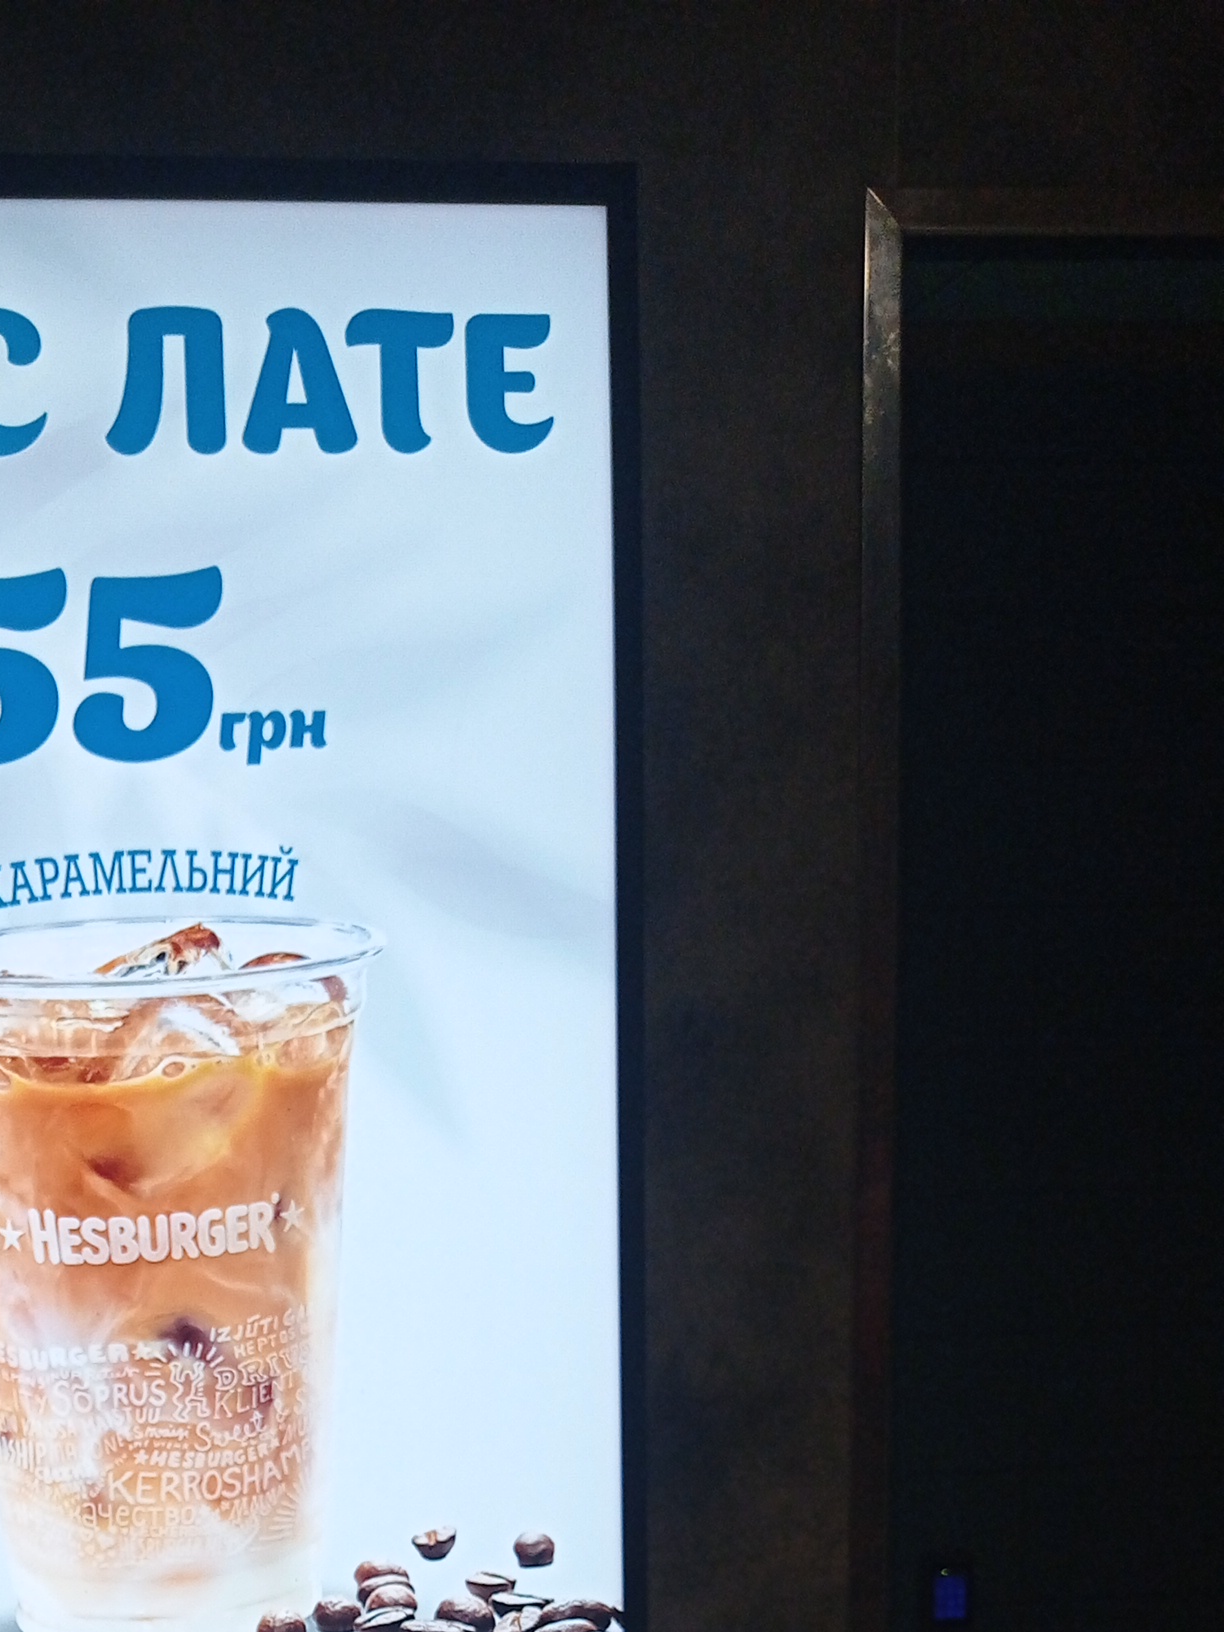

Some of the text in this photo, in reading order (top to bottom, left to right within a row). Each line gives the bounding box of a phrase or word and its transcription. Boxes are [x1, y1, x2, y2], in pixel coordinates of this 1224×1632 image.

[105, 305, 555, 456] ЛАТЕ
[218, 699, 328, 765] грн
[27, 1201, 279, 1266] HESBURGER
[50, 1377, 167, 1417] SÕPRUS
